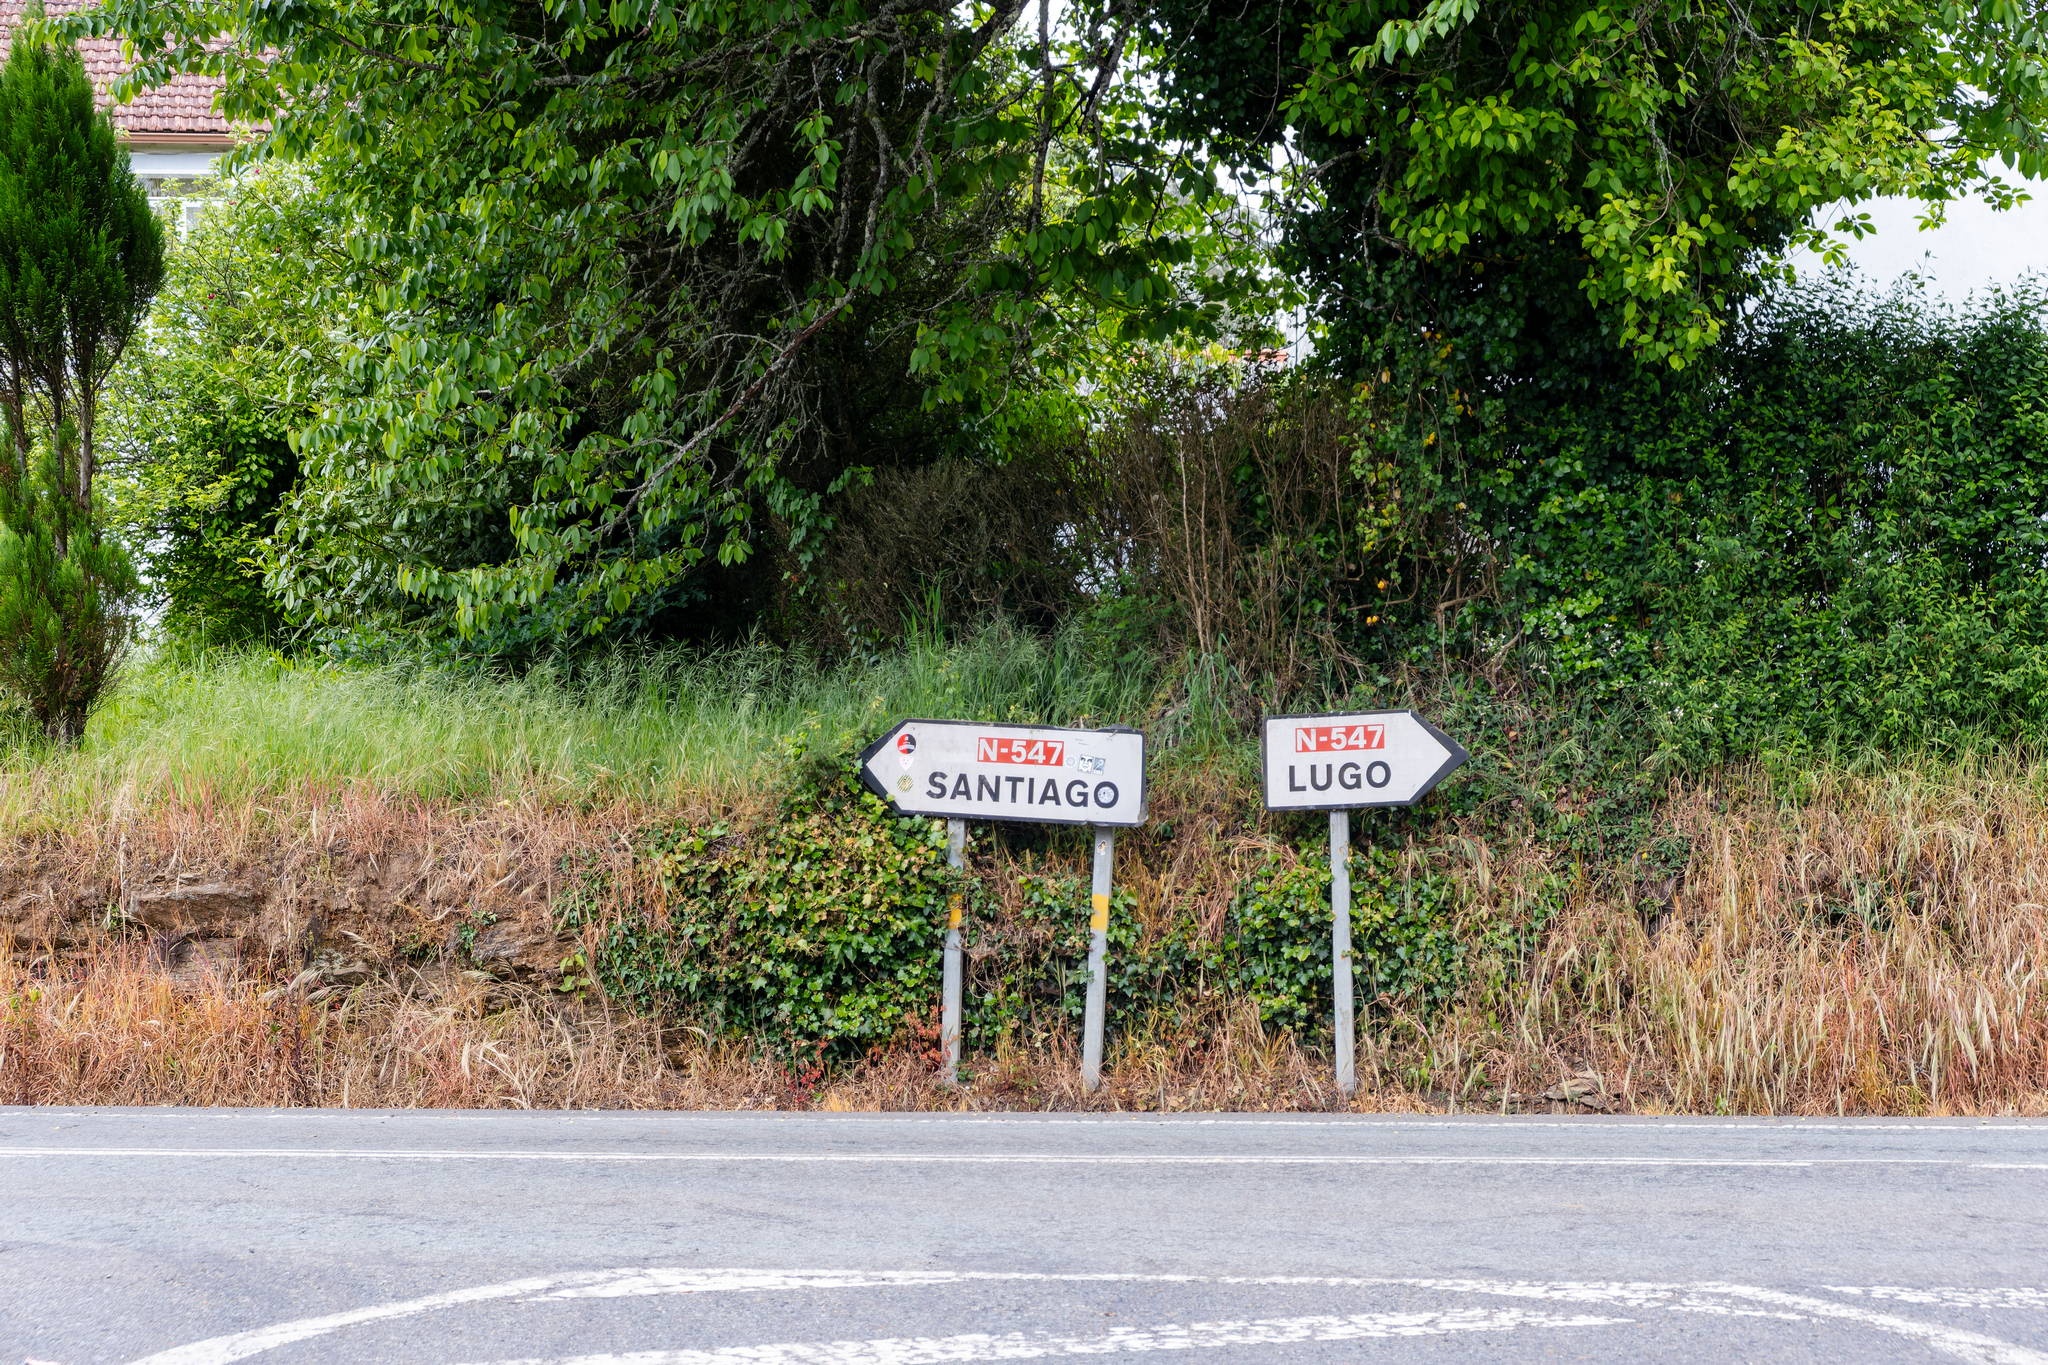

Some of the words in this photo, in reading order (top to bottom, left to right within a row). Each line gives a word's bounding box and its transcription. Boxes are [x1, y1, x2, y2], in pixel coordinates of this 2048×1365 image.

[978, 738, 1064, 766] N-547
[1296, 725, 1384, 751] N-547
[926, 771, 1119, 808] SANTIAGO
[1289, 760, 1392, 792] LUGO
